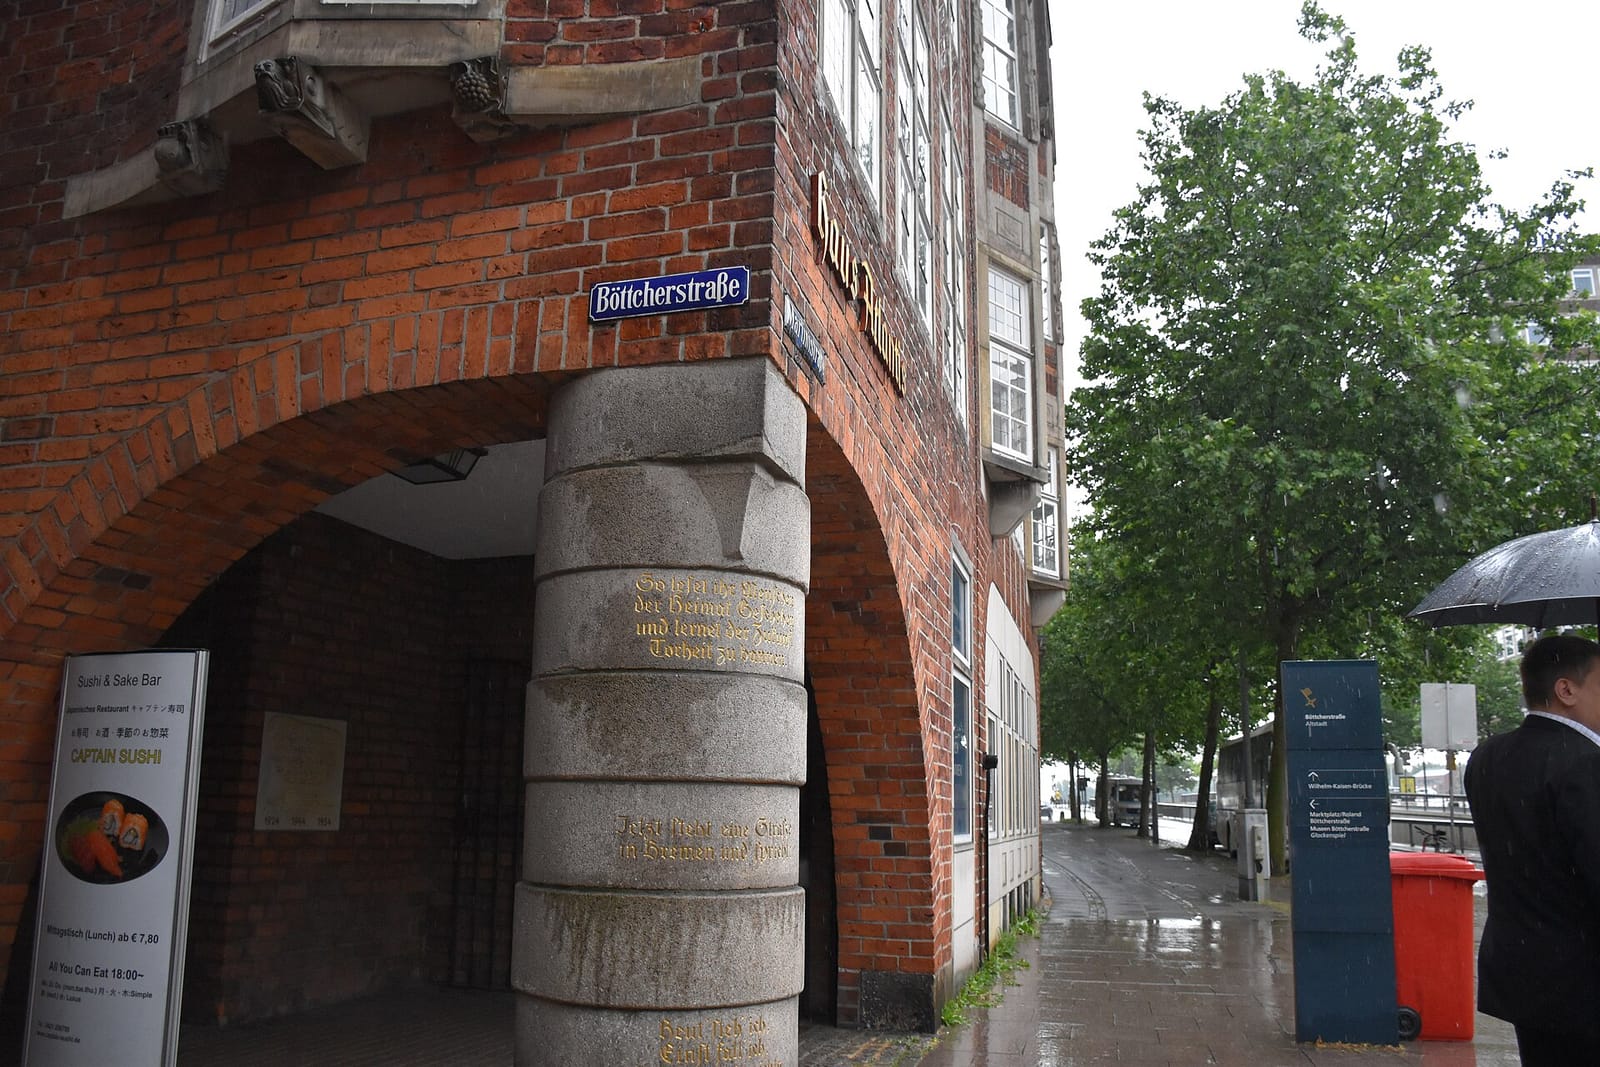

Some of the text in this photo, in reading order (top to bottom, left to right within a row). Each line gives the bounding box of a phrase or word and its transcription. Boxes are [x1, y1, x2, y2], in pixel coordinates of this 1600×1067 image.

[595, 271, 740, 314] Böttcherstraße
[634, 595, 664, 613] der
[669, 593, 731, 616] Heimat
[636, 617, 669, 637] und
[725, 620, 750, 640] der
[650, 637, 713, 660] Torheit
[716, 646, 736, 665] zu
[77, 673, 162, 689] Sushi & Sake Bar
[96, 704, 129, 713] Restaurant
[1305, 713, 1346, 721] Böttcherstraße
[71, 748, 162, 764] CAPTAIN SUSHI
[619, 842, 638, 859] in
[719, 841, 749, 861] und
[85, 930, 116, 942] (Lunch)
[117, 932, 129, 942] ab
[131, 933, 137, 943] €
[139, 934, 159, 945] 7,80
[48, 961, 59, 972] All
[59, 962, 74, 974] You
[74, 964, 91, 976] Can
[93, 966, 109, 978] Eat
